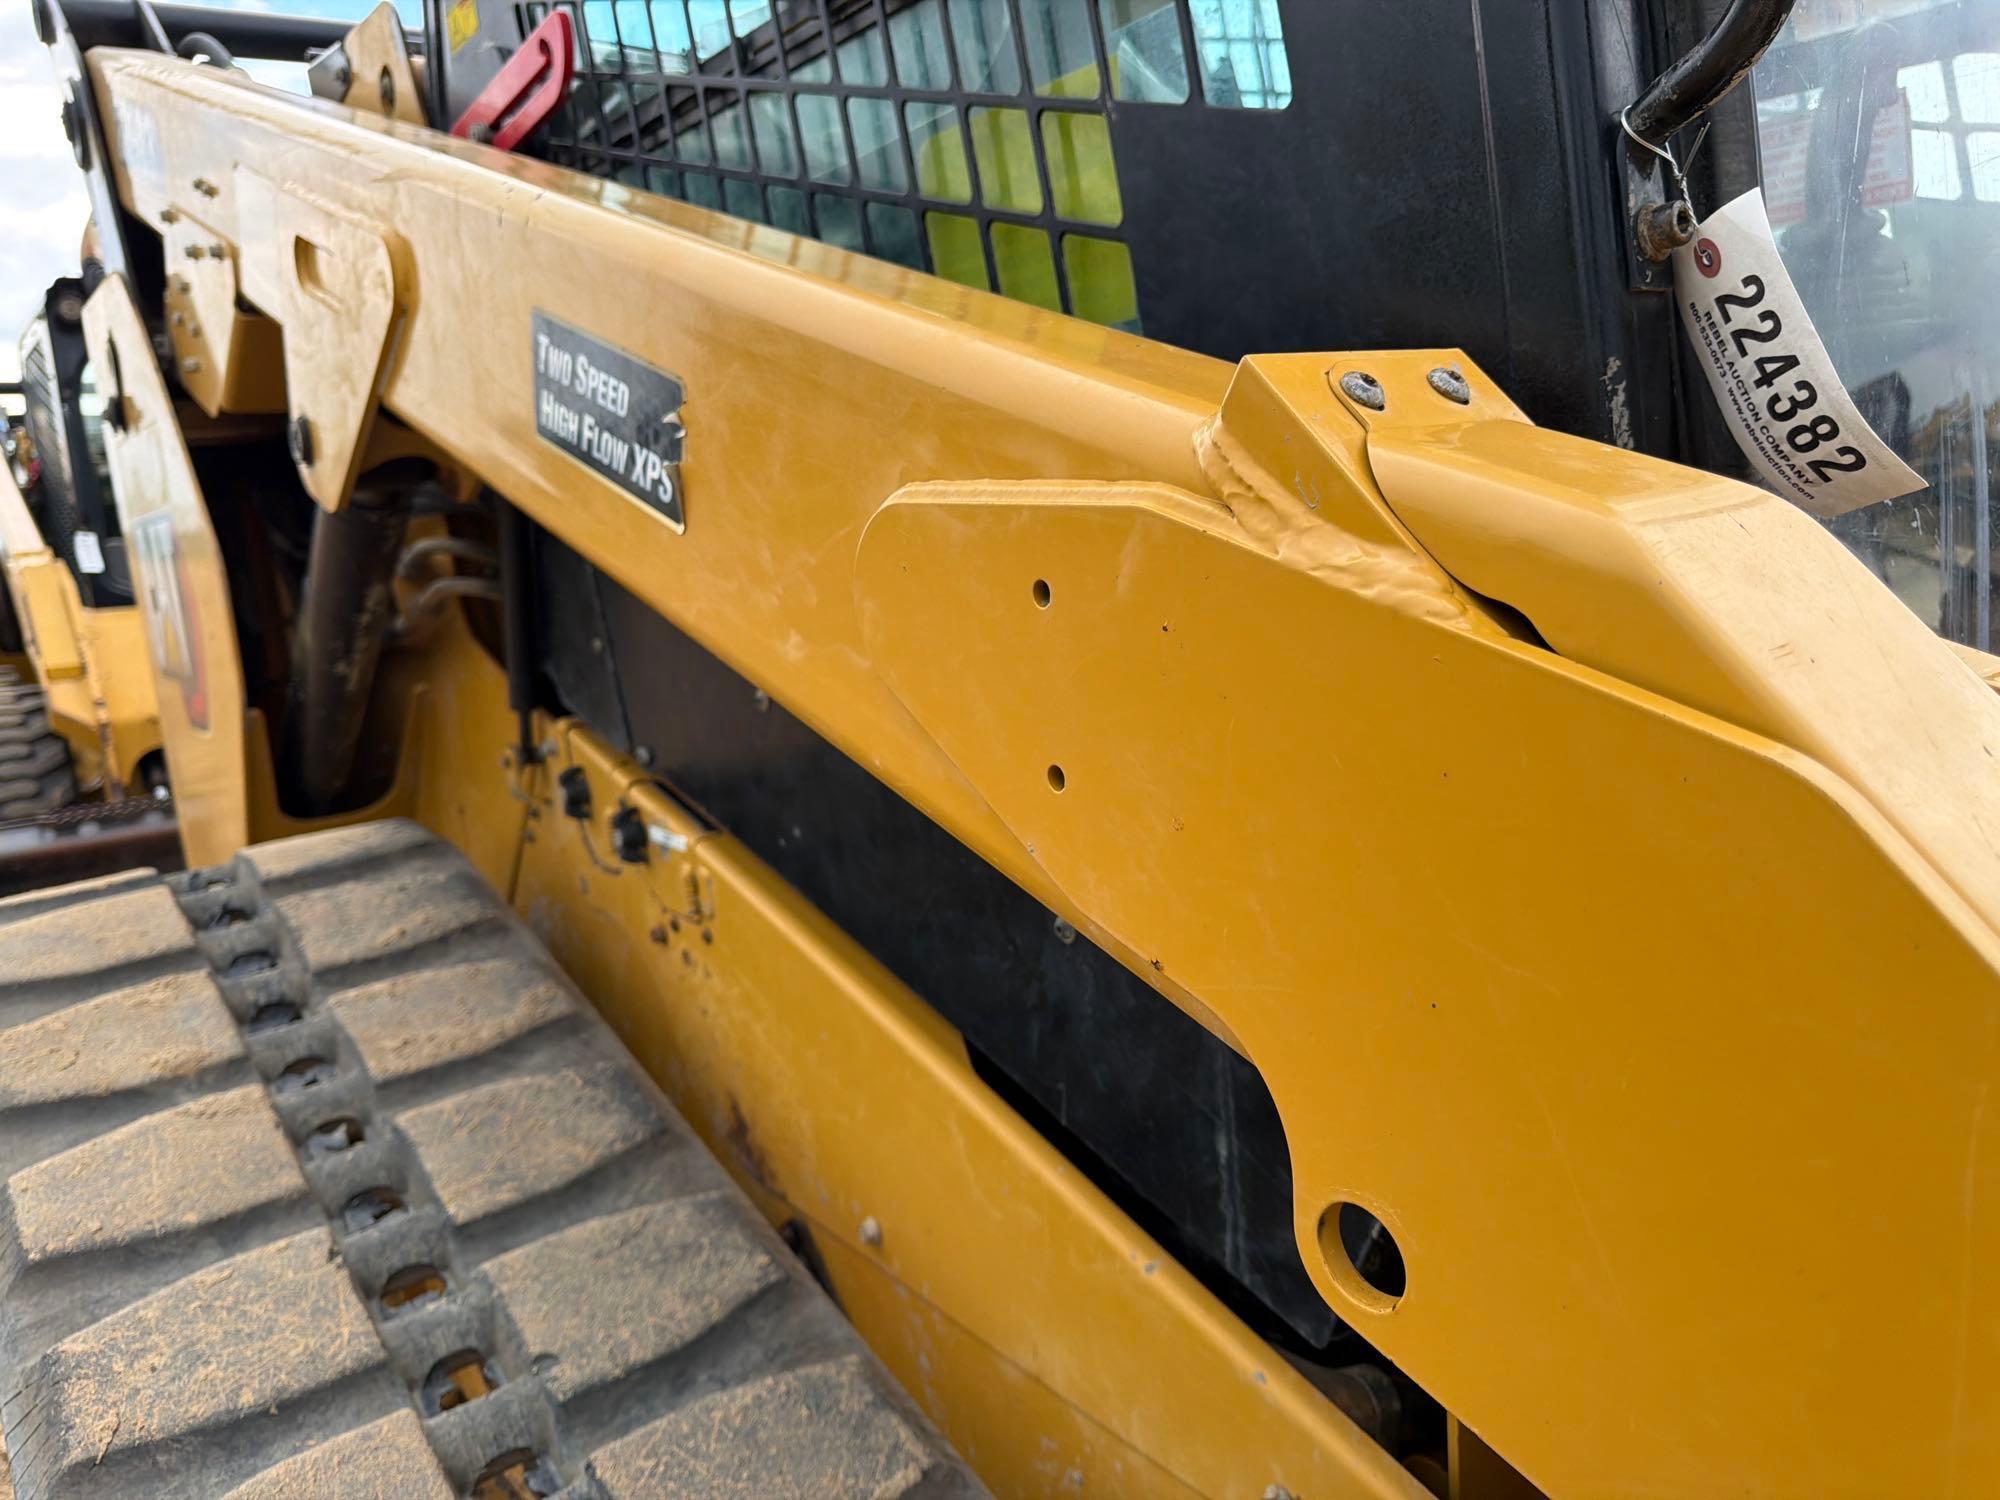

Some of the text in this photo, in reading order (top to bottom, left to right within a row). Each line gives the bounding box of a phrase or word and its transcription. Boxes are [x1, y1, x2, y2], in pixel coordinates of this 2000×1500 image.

[631, 440, 674, 504] XPS
[1689, 301, 1815, 501] 800-533-0673 www.rebelauction.com
[1703, 311, 1814, 486] REBEL AUCTION COMPANY
[1714, 273, 1867, 484] 224382
